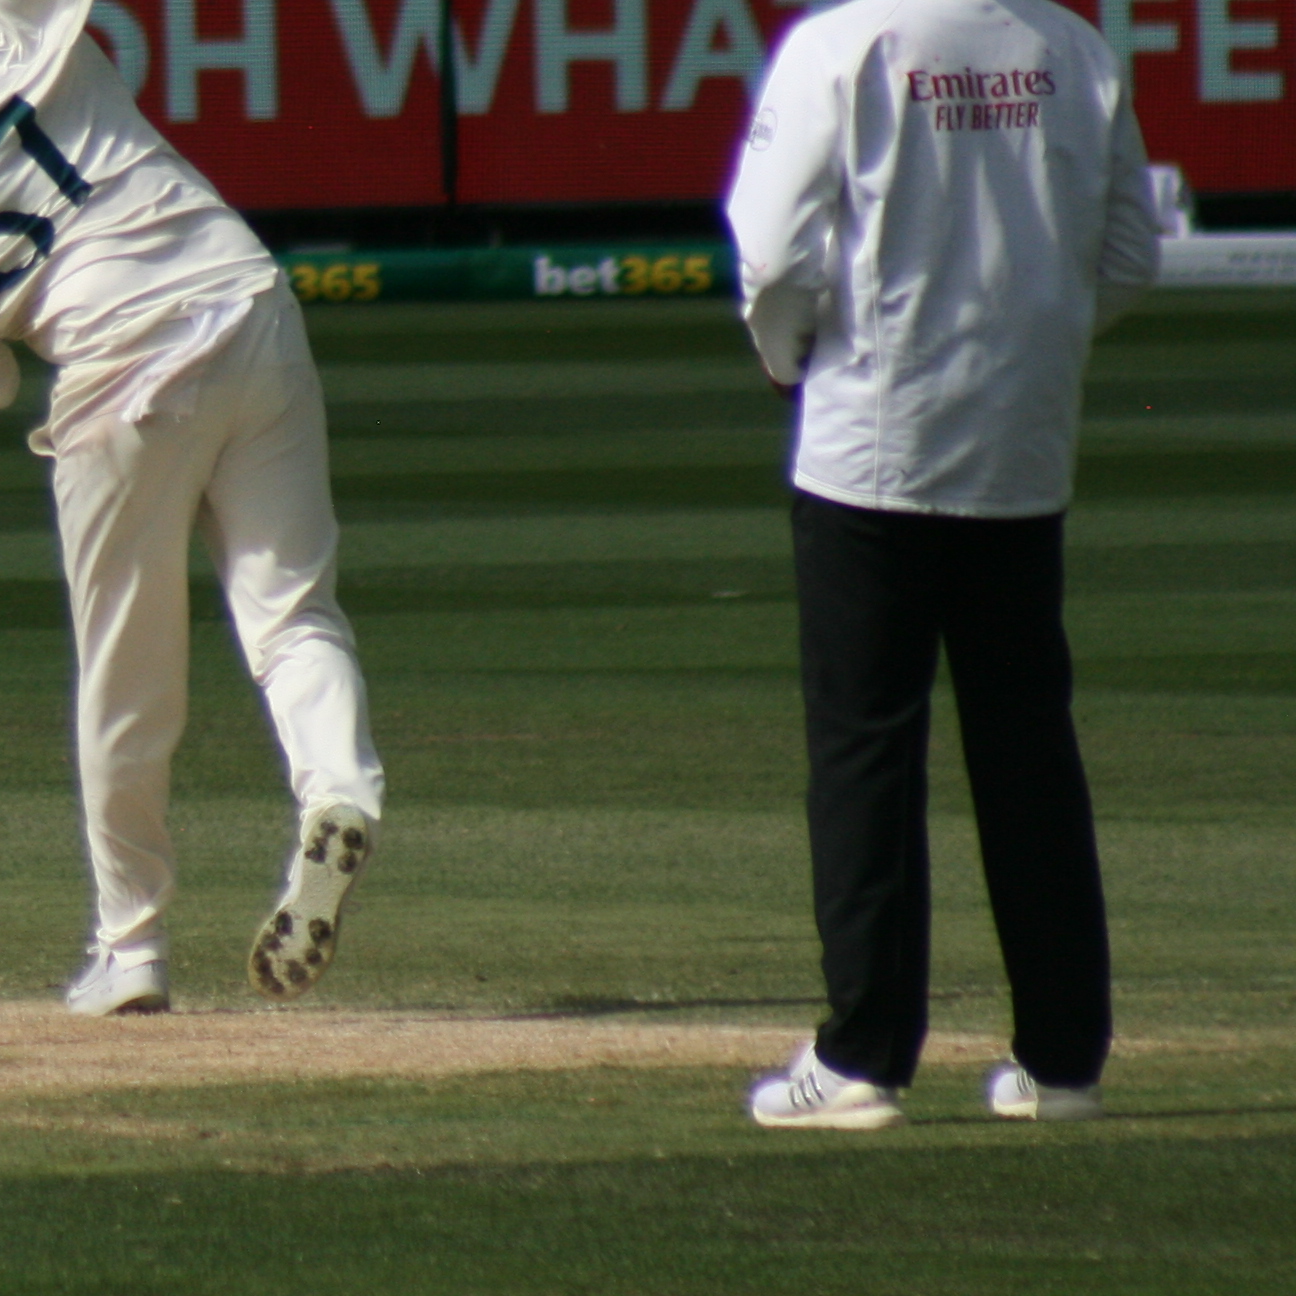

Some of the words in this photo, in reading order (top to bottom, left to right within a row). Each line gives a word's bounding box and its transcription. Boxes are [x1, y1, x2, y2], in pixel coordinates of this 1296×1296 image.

[907, 67, 1056, 101] Emirates
[936, 105, 965, 131] FLY
[971, 102, 1040, 131] BETTER
[534, 254, 712, 296] bet365
